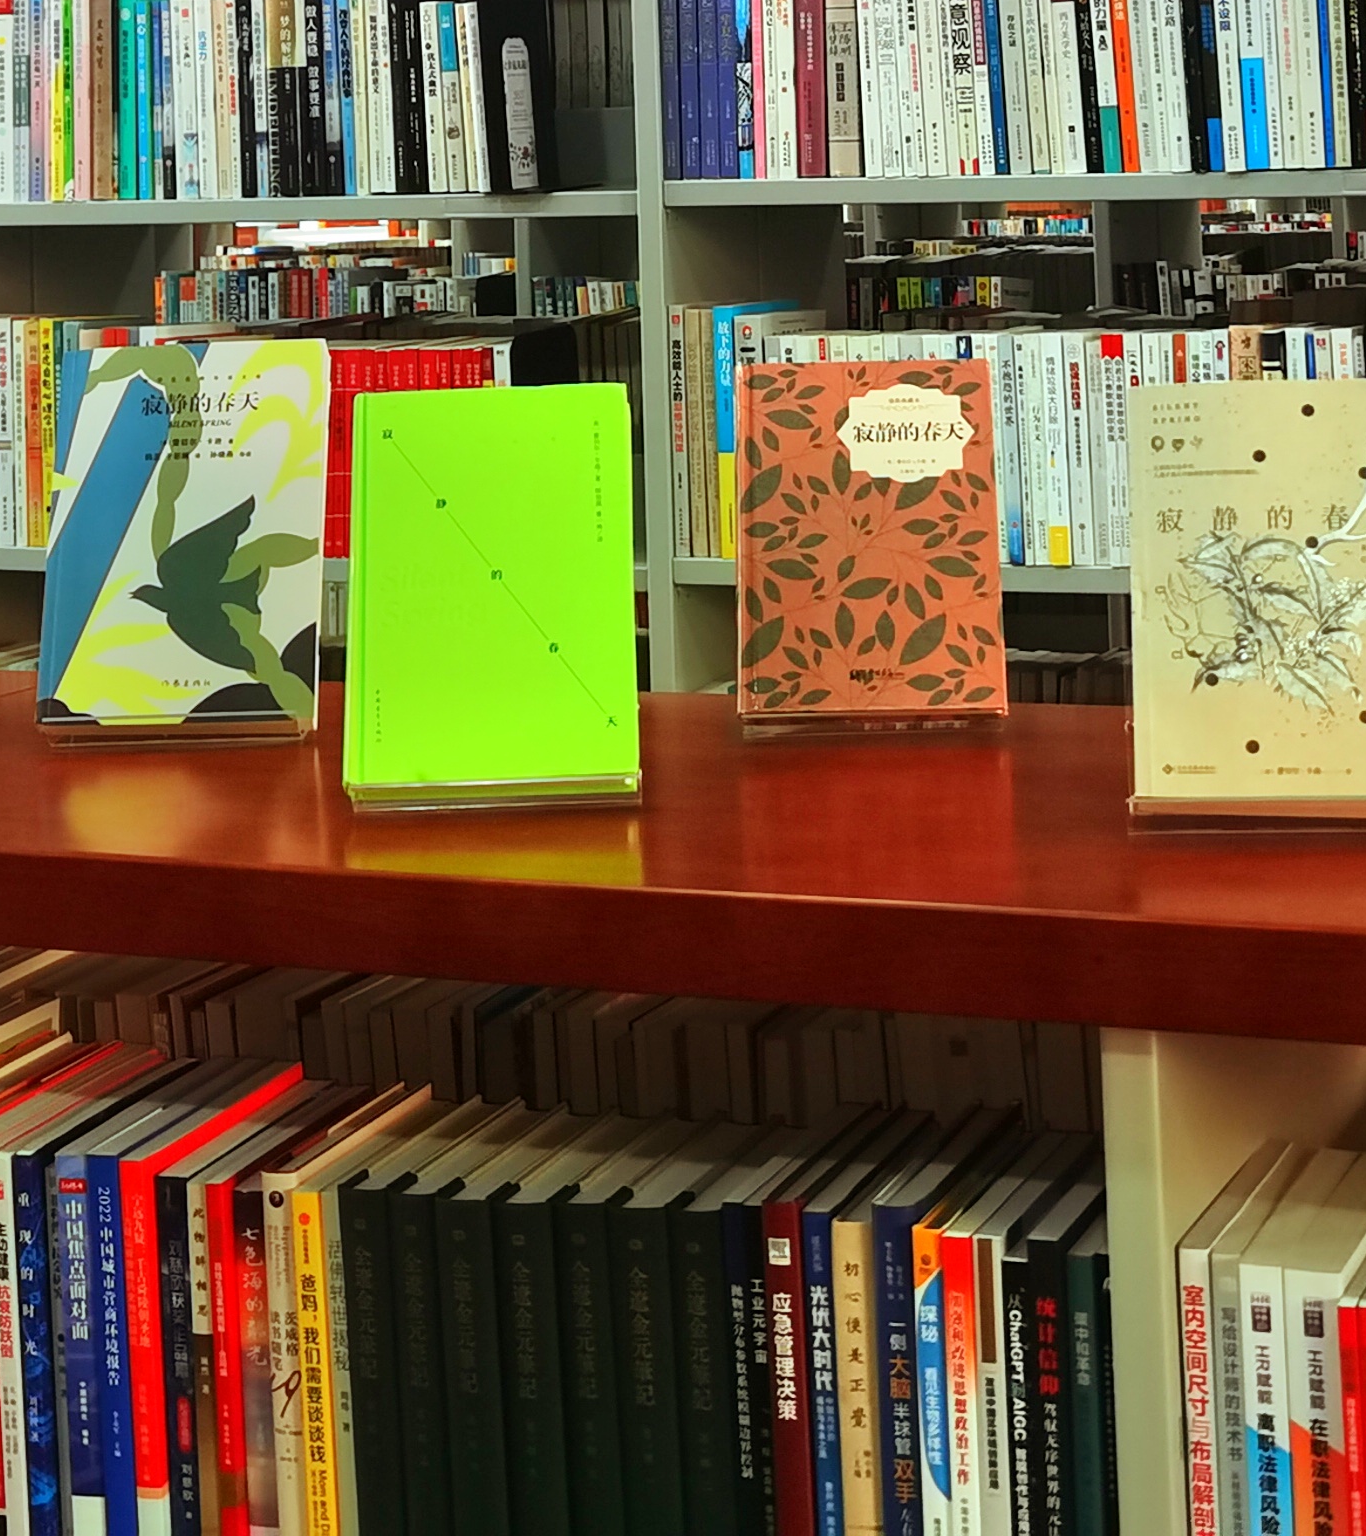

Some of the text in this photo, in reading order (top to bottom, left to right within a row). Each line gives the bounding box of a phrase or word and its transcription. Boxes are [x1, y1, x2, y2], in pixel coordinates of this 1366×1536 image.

[141, 390, 260, 416] 寂静的春天
[852, 420, 965, 444] 寂静的春天
[65, 1199, 90, 1342] 中国焦点面对面
[98, 1187, 121, 1386] 2022 中国城市营商环境报告
[771, 1291, 799, 1421] 应急管理决策
[809, 1284, 834, 1393] 光伏大时代
[1257, 1412, 1282, 1536] 离职法律风险
